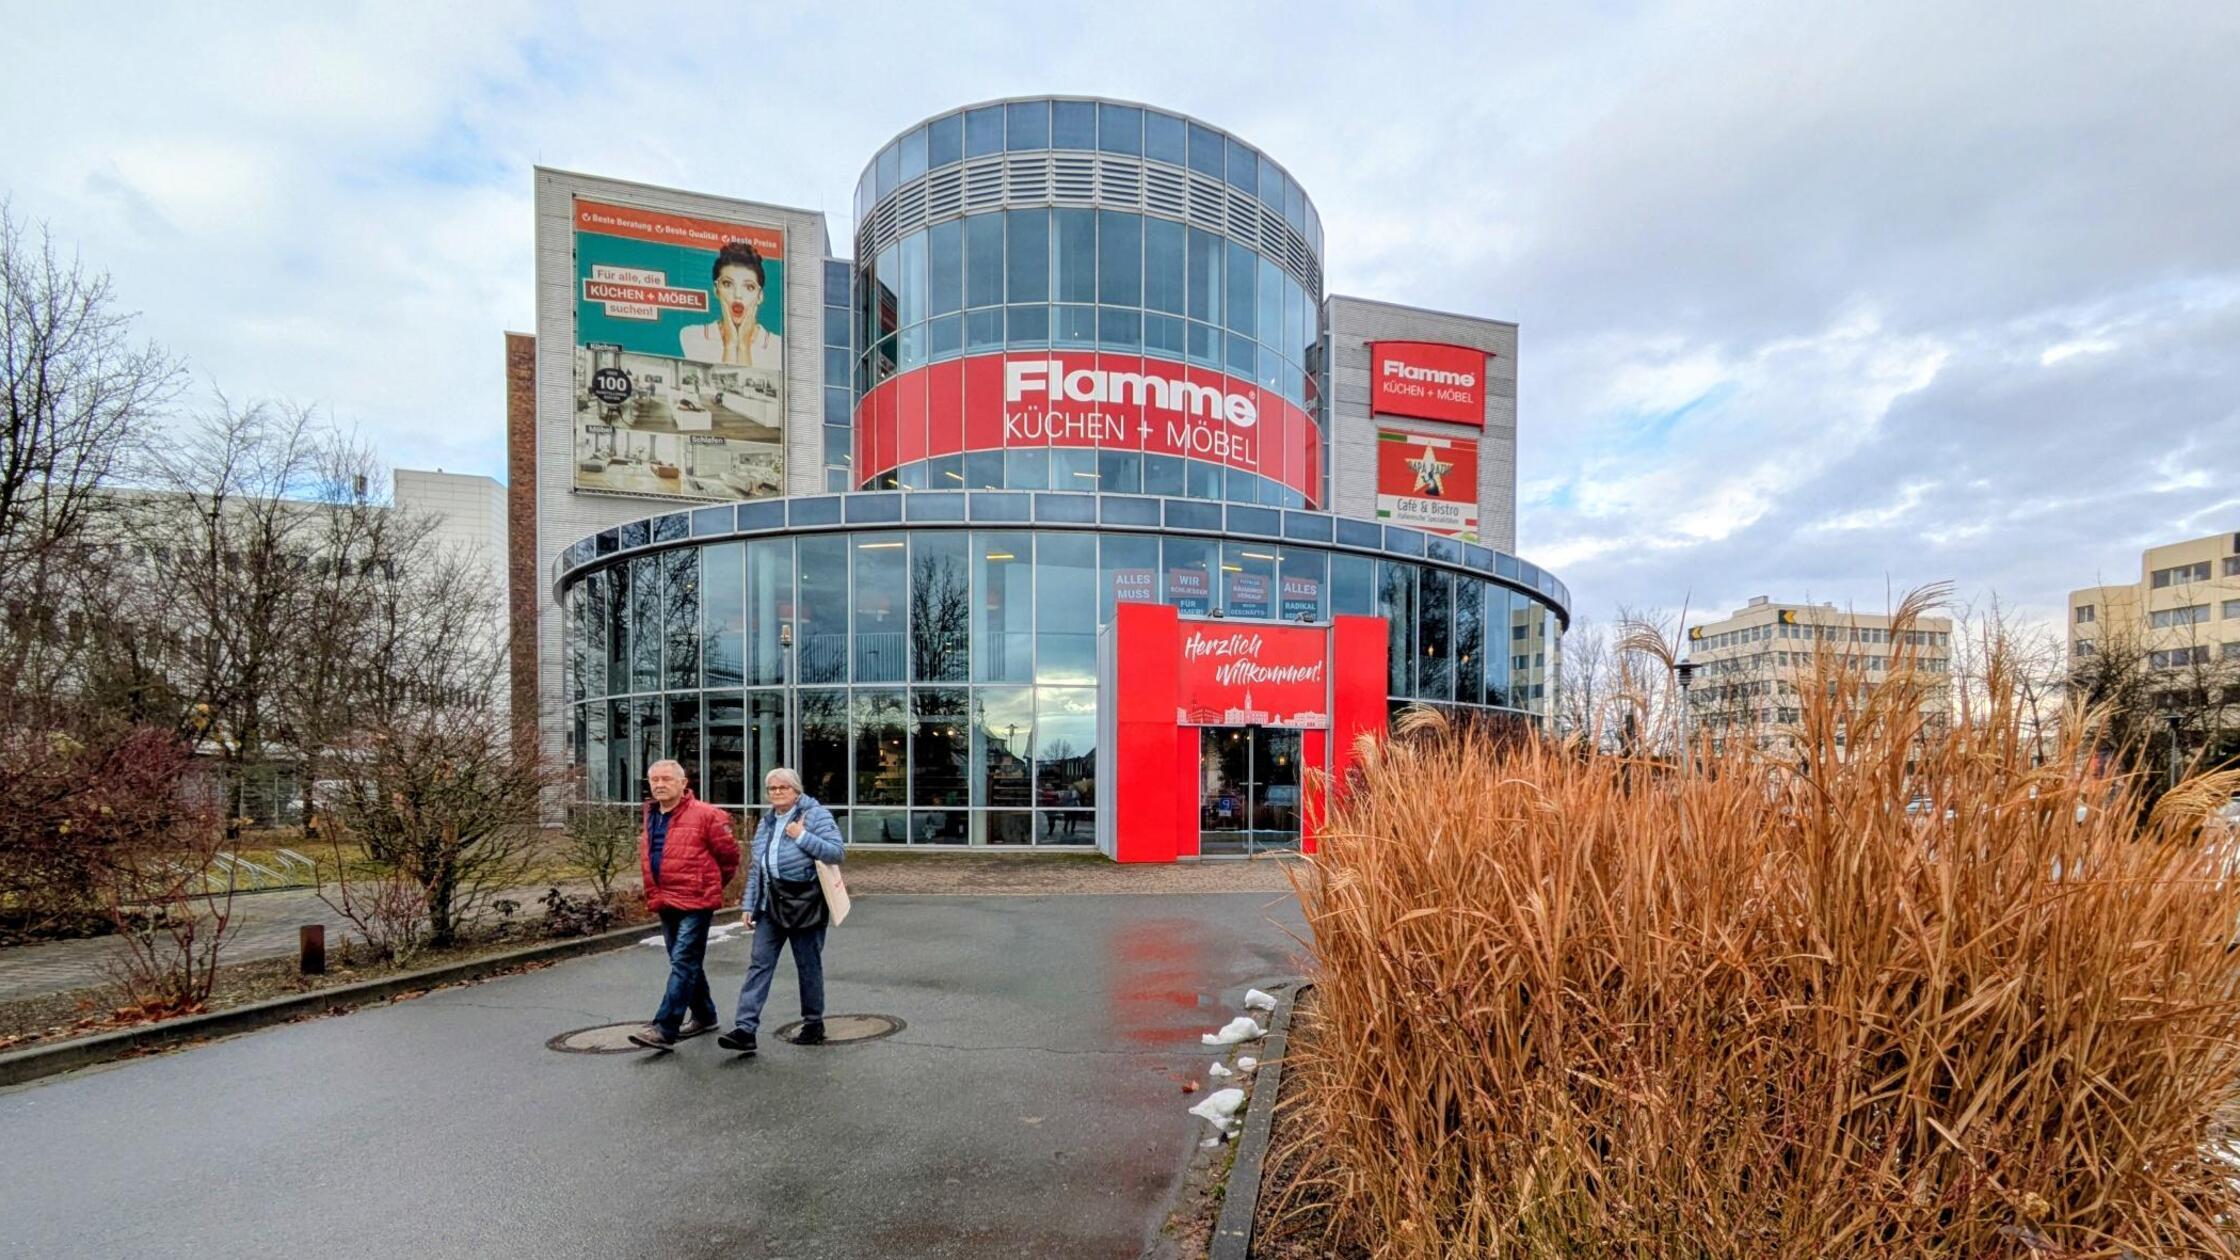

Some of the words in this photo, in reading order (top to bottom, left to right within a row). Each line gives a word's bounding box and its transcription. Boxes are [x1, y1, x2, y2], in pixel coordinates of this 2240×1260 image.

[592, 214, 615, 225] Beste
[616, 217, 652, 233] Beratung
[665, 225, 687, 236] Beste
[688, 228, 719, 241] Qualität
[731, 235, 752, 245] Beste
[753, 237, 777, 248] Preise
[597, 269, 615, 280] Für
[618, 271, 641, 284] alle,
[644, 274, 661, 285] die
[590, 284, 645, 301] KÜCHEN
[647, 292, 656, 301] +
[658, 291, 703, 306] MÖBEL
[610, 304, 653, 316] suchen!
[590, 343, 619, 352] Küchen
[597, 376, 627, 391] 100
[1383, 380, 1425, 397] KÜCHEN
[1437, 388, 1474, 403] MÖBEL
[588, 426, 613, 434] Möbel
[1006, 405, 1125, 440] KÜCHEN
[1137, 422, 1154, 439] +
[1167, 419, 1257, 465] MÖBEL
[1397, 498, 1417, 512] Café
[1420, 501, 1428, 513] &
[1431, 502, 1459, 516] Bistro
[1116, 574, 1150, 585] ALLES
[1180, 575, 1200, 586] WIR
[1117, 589, 1150, 598] MUSS
[1284, 582, 1317, 596] ALLES
[1180, 600, 1196, 608] FÜR
[1284, 602, 1316, 610] RADIKAL
[1185, 632, 1263, 663] Herzlich
[1215, 657, 1323, 687] Willkommen!
